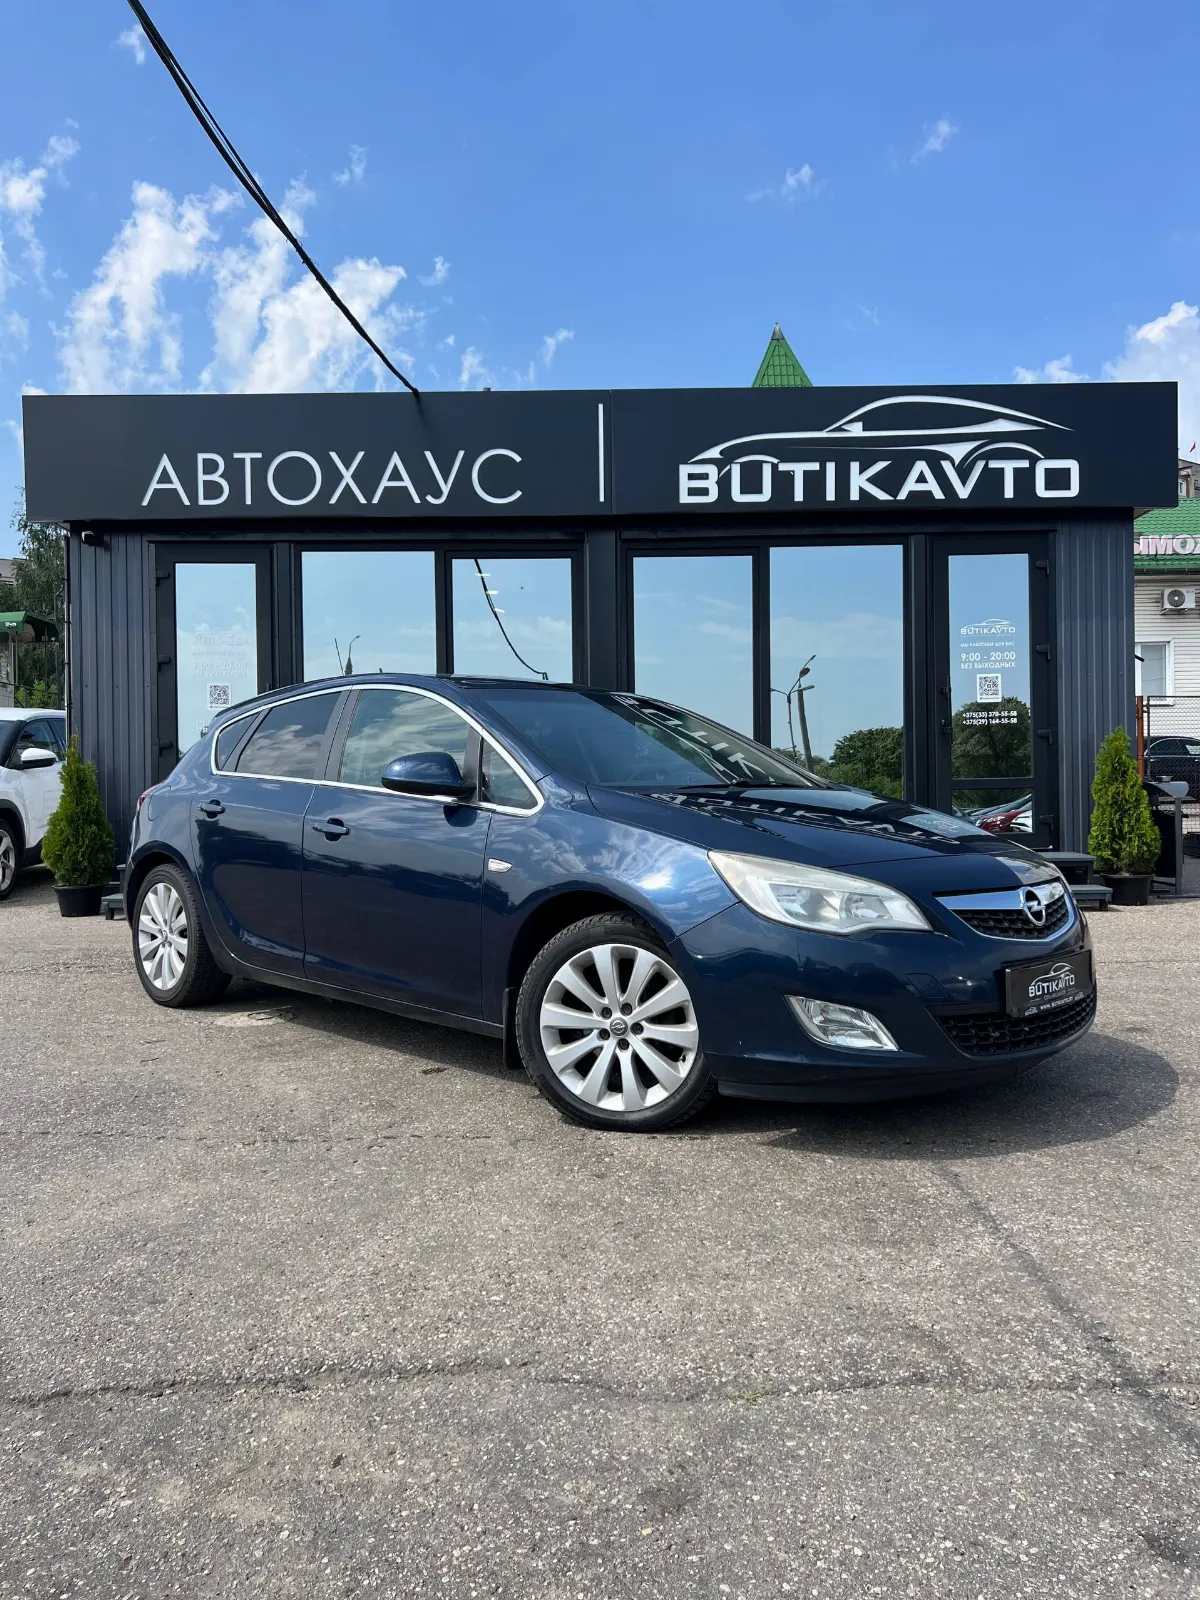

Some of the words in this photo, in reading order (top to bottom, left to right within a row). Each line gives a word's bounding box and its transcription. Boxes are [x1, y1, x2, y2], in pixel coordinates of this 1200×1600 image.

[141, 448, 523, 506] АВТОХАУС
[678, 458, 1080, 504] BUTIKAVTO
[960, 627, 1016, 635] BUTIKAVTO
[961, 652, 980, 662] 9:00
[990, 652, 1016, 660] 20:00
[974, 661, 1016, 669] ВЫХОДНЫХ
[1028, 974, 1075, 997] BUTIKAVTO
